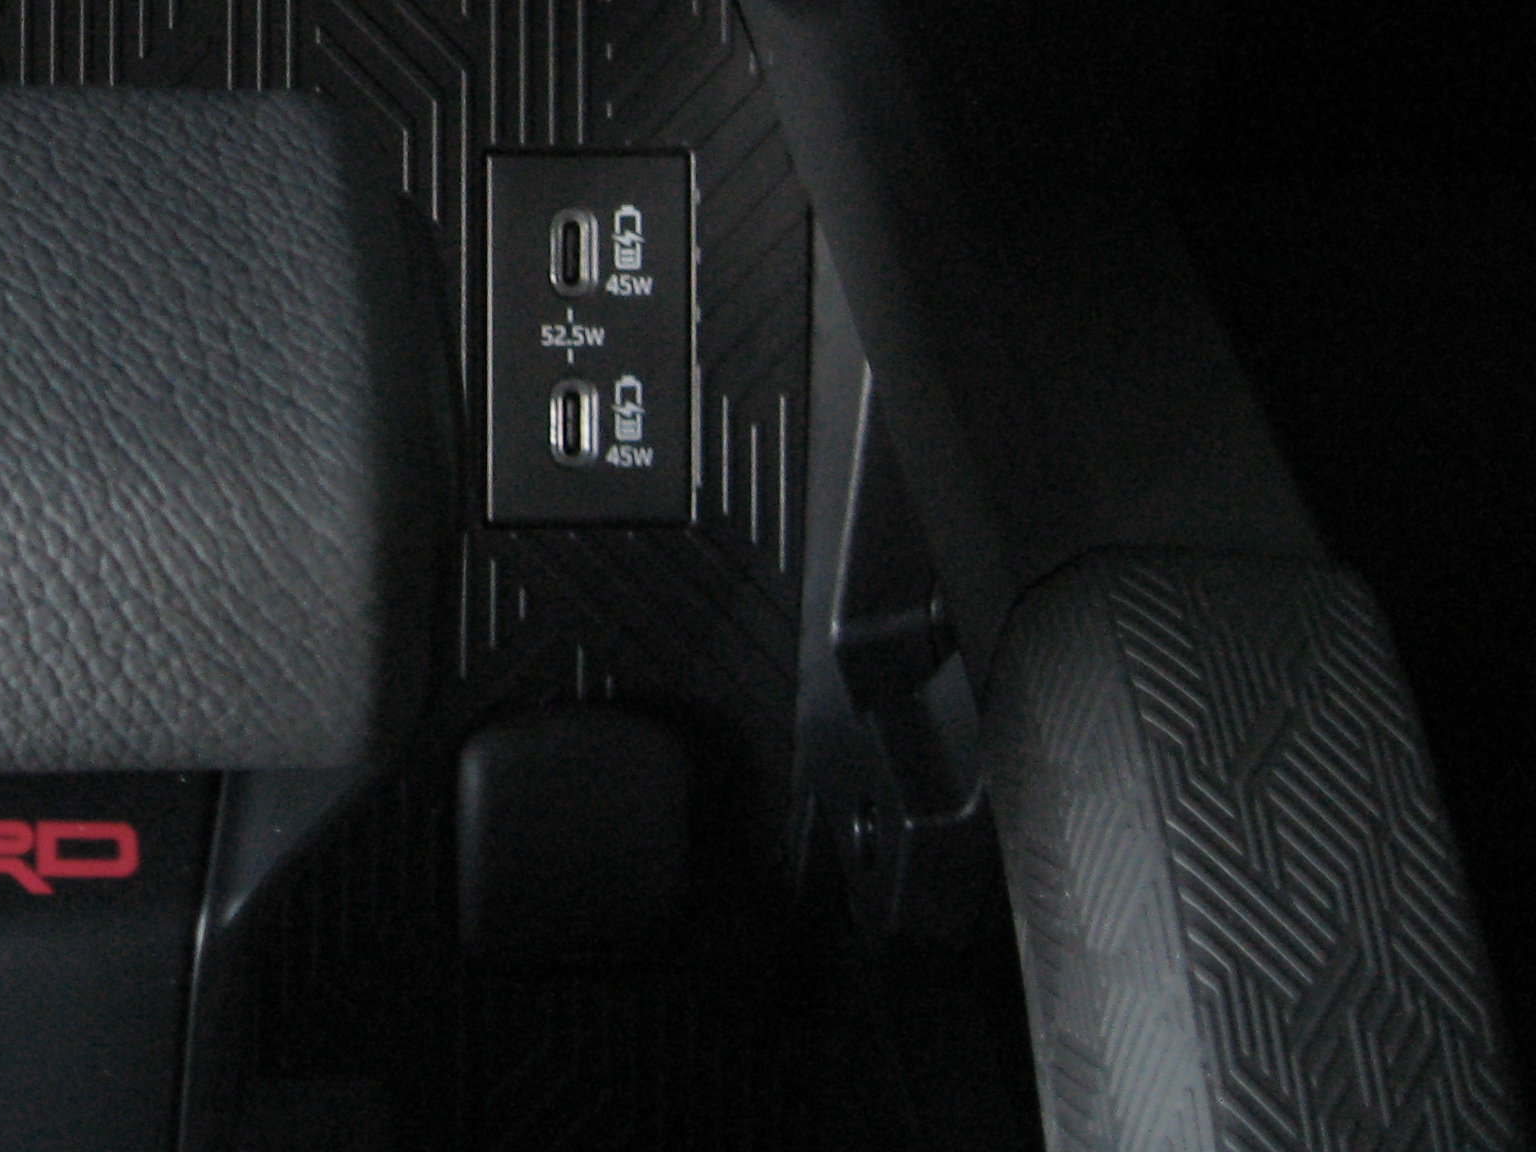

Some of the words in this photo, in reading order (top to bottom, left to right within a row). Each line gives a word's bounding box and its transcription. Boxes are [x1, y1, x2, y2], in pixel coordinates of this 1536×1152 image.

[605, 274, 653, 297] 45W
[540, 324, 605, 348] 52.5W
[605, 445, 654, 468] 45W
